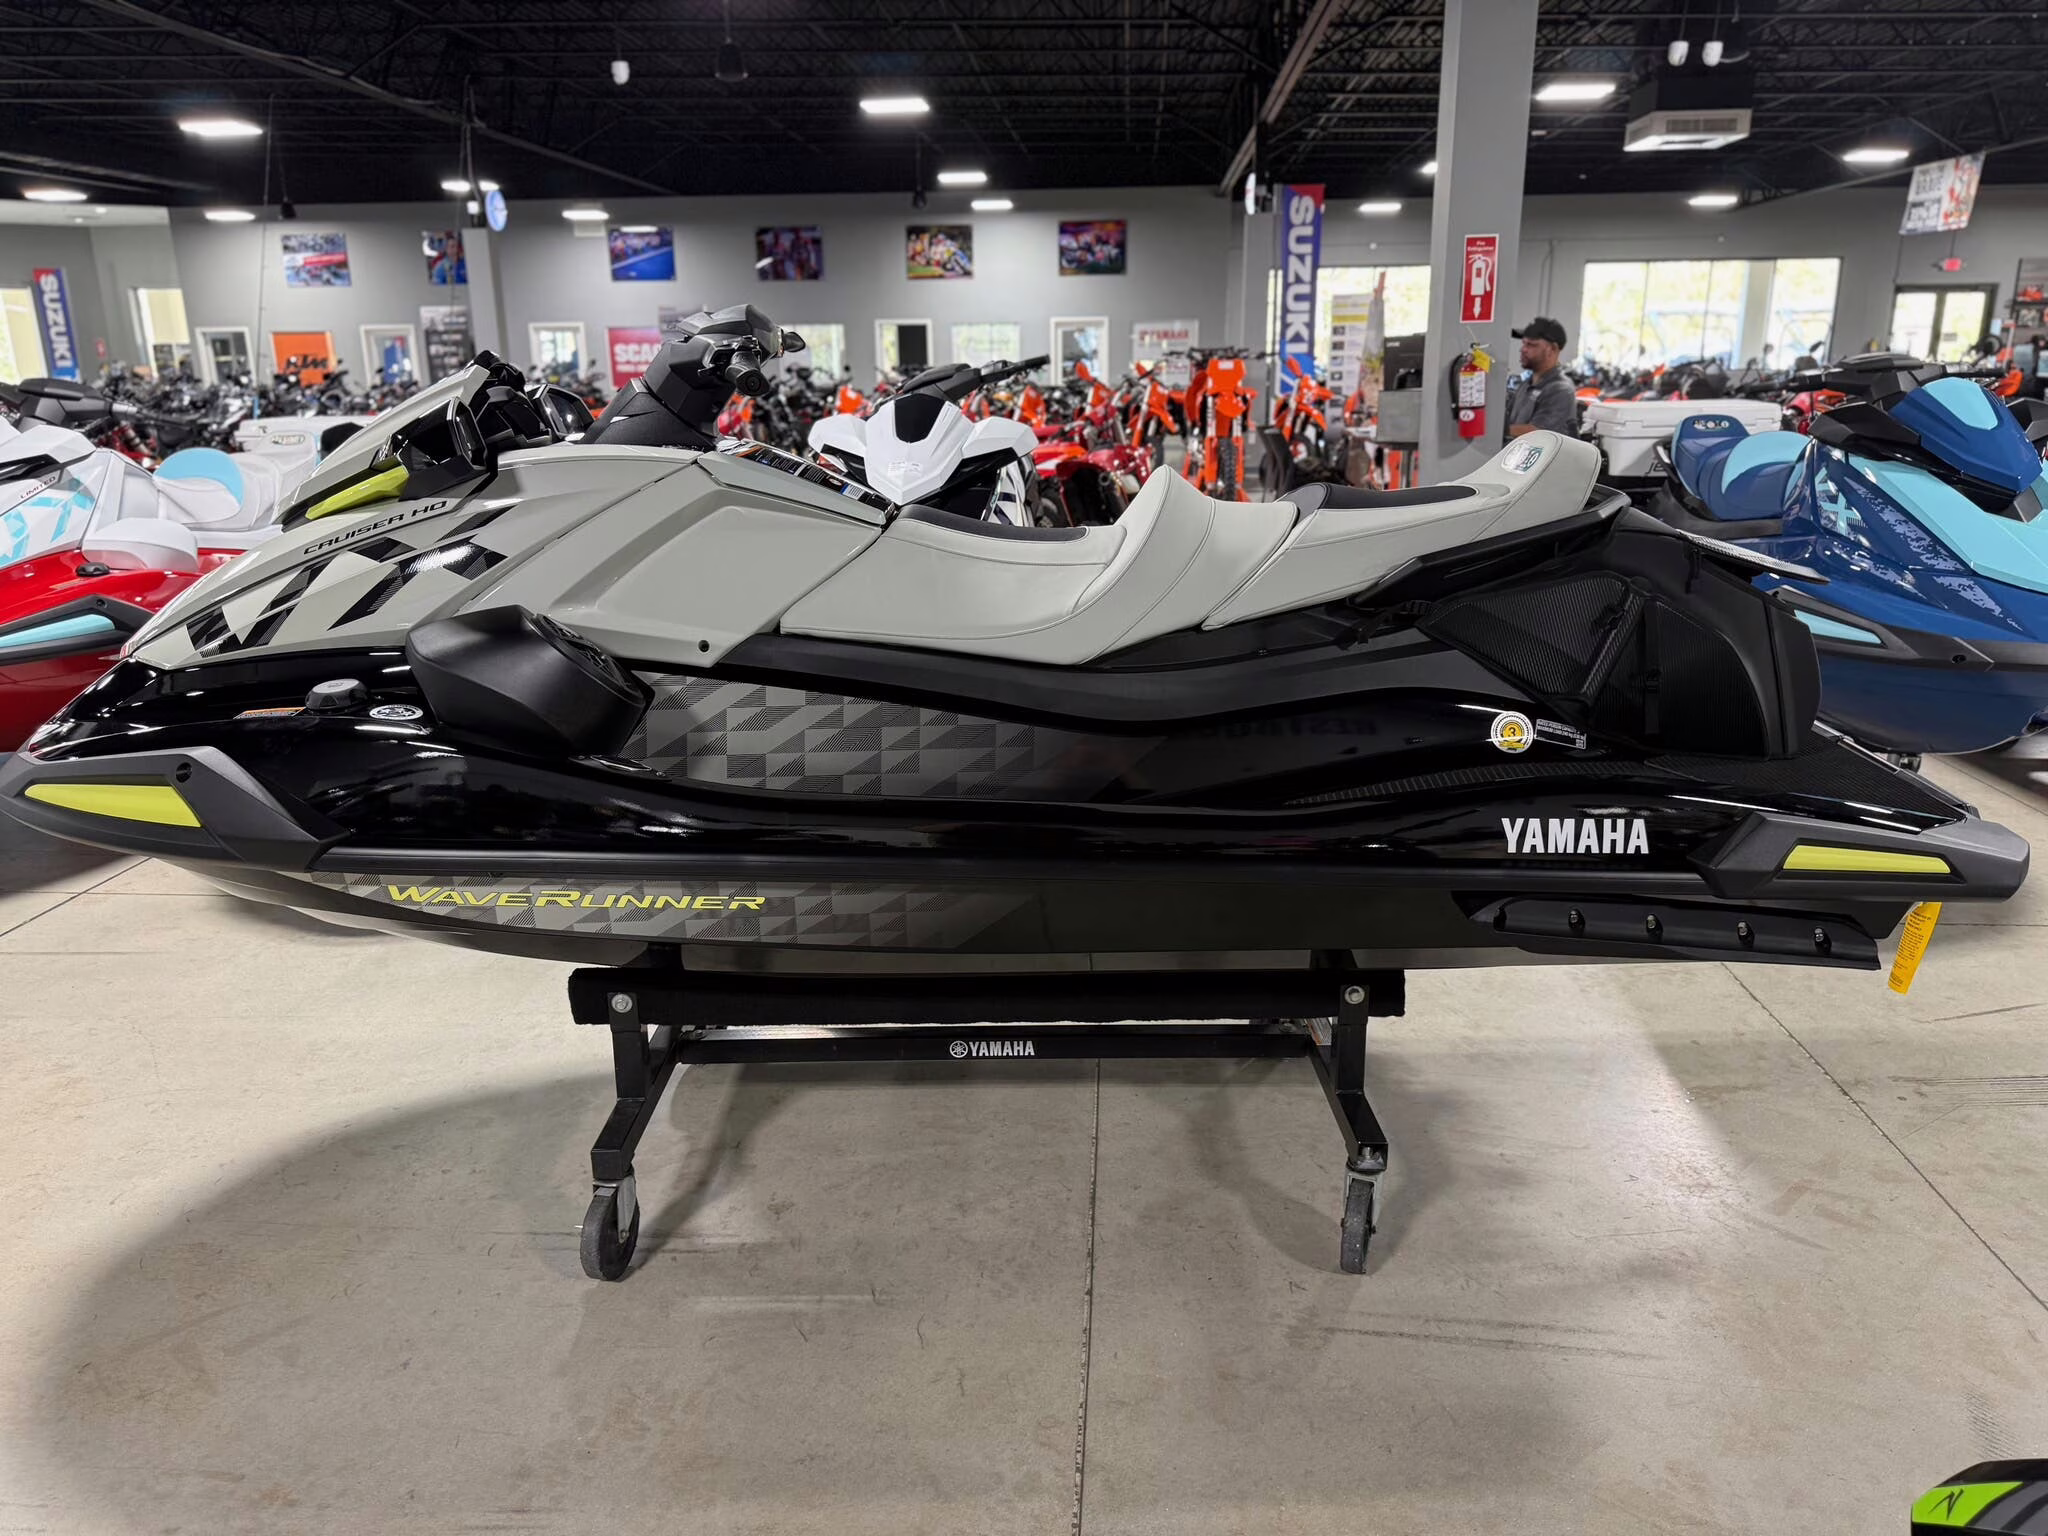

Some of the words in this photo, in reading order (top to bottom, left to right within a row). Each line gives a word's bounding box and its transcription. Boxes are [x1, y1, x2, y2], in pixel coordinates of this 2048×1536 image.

[1285, 195, 1315, 354] SUZUKI
[40, 273, 73, 368] SUZUKI
[20, 476, 56, 499] LIMITED
[303, 514, 404, 555] CRUISER
[411, 500, 448, 517] HO
[1501, 818, 1649, 854] YAMAHA
[969, 1041, 1035, 1057] YAMAHA
